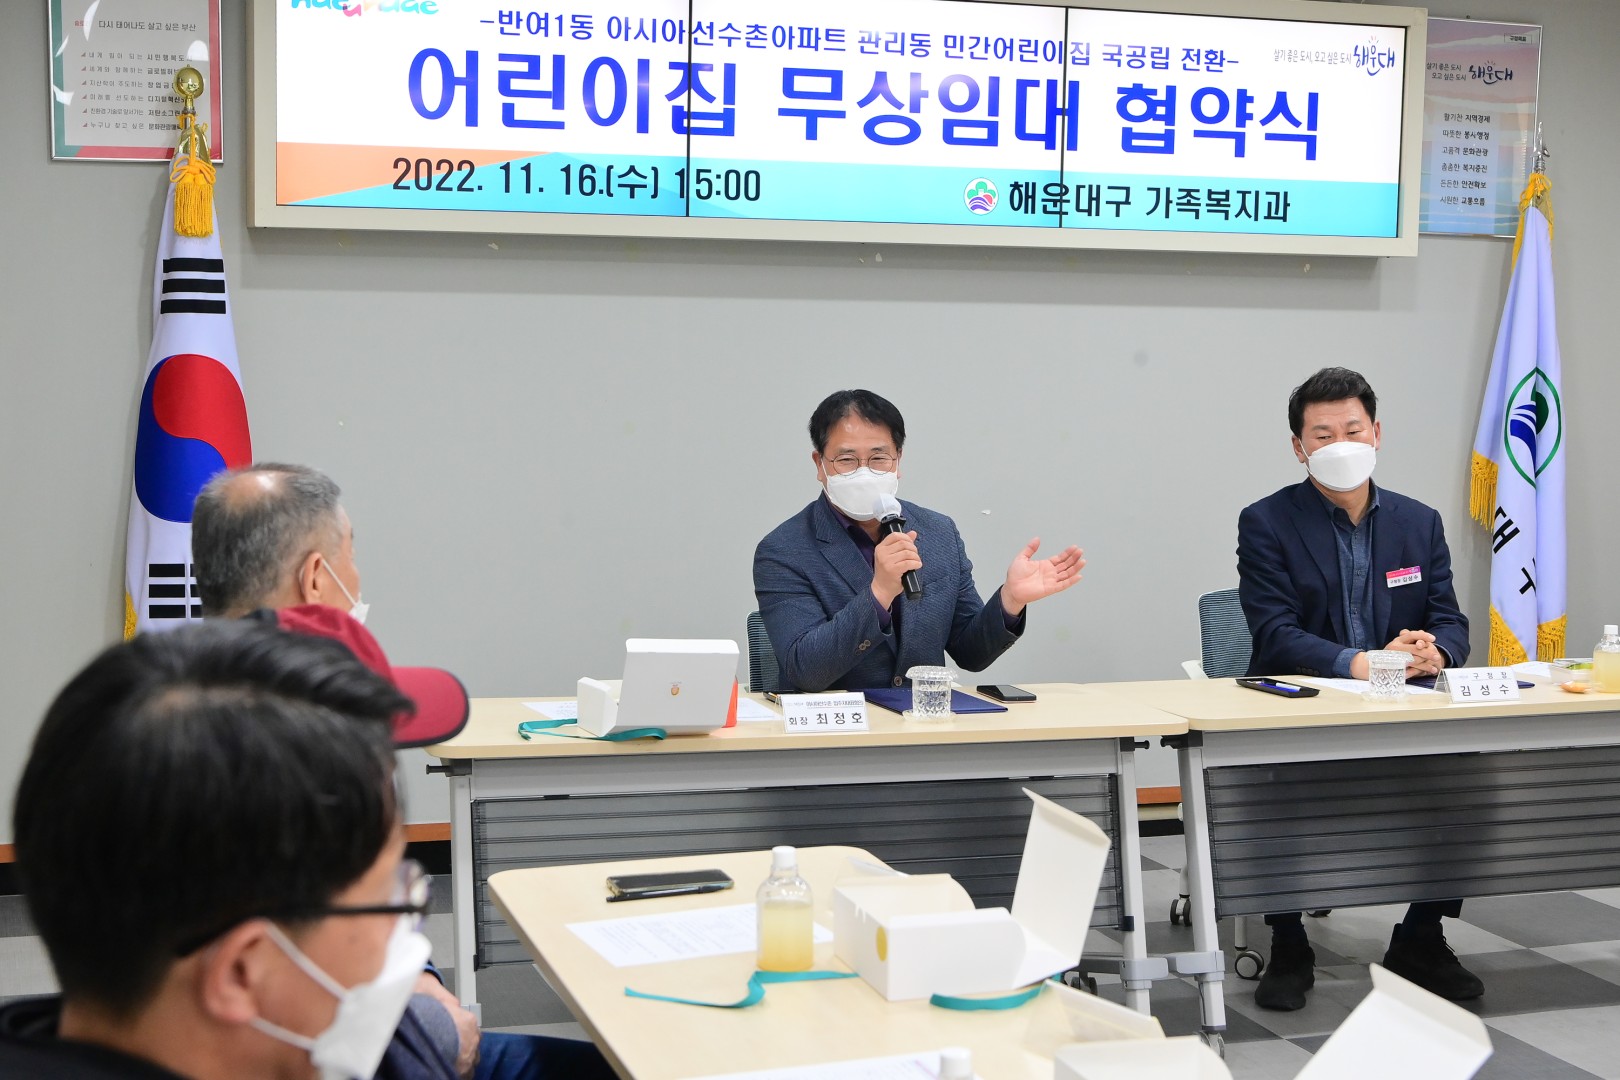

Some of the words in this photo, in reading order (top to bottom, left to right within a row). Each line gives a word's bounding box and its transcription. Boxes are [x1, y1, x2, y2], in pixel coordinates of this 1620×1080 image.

[98, 20, 113, 29] 다시
[116, 20, 146, 30] 태어나도
[148, 22, 162, 31] 살고
[165, 23, 179, 31] 싶은
[181, 23, 197, 32] 부산
[607, 15, 846, 52] 아시아선수촌아파트
[857, 29, 932, 59] 관리동
[943, 34, 1092, 66] 민간어린이집
[1103, 43, 1170, 70] 국공립
[147, 54, 192, 62] 시민행복도
[1274, 49, 1286, 62] 살기
[1287, 49, 1298, 63] 좋은
[1315, 51, 1326, 63] 오고
[1340, 52, 1352, 64] 도시
[1353, 44, 1396, 76] 해운대
[147, 67, 180, 75] 글로벌허
[1426, 62, 1438, 70] 살기
[1450, 63, 1462, 71] 도시
[1432, 72, 1443, 80] 오고
[1469, 65, 1514, 85] 해운대
[148, 95, 185, 103] 디지털혁신
[408, 47, 737, 137] 어린이집
[778, 66, 1080, 152] 무상임대
[1115, 82, 1320, 161] 협약식
[148, 109, 182, 117] 저탄소그린
[1465, 114, 1491, 124] 지역경제
[1464, 130, 1490, 141] 봉사행정
[391, 157, 484, 192] 2022.
[498, 161, 545, 194] 11.
[673, 167, 761, 202] 15:00
[1009, 181, 1132, 219] 해운대구
[1145, 185, 1291, 223] 가족복지과
[1460, 683, 1510, 697] 김성수
[788, 716, 808, 726] 회장
[816, 712, 864, 725] 최정호
